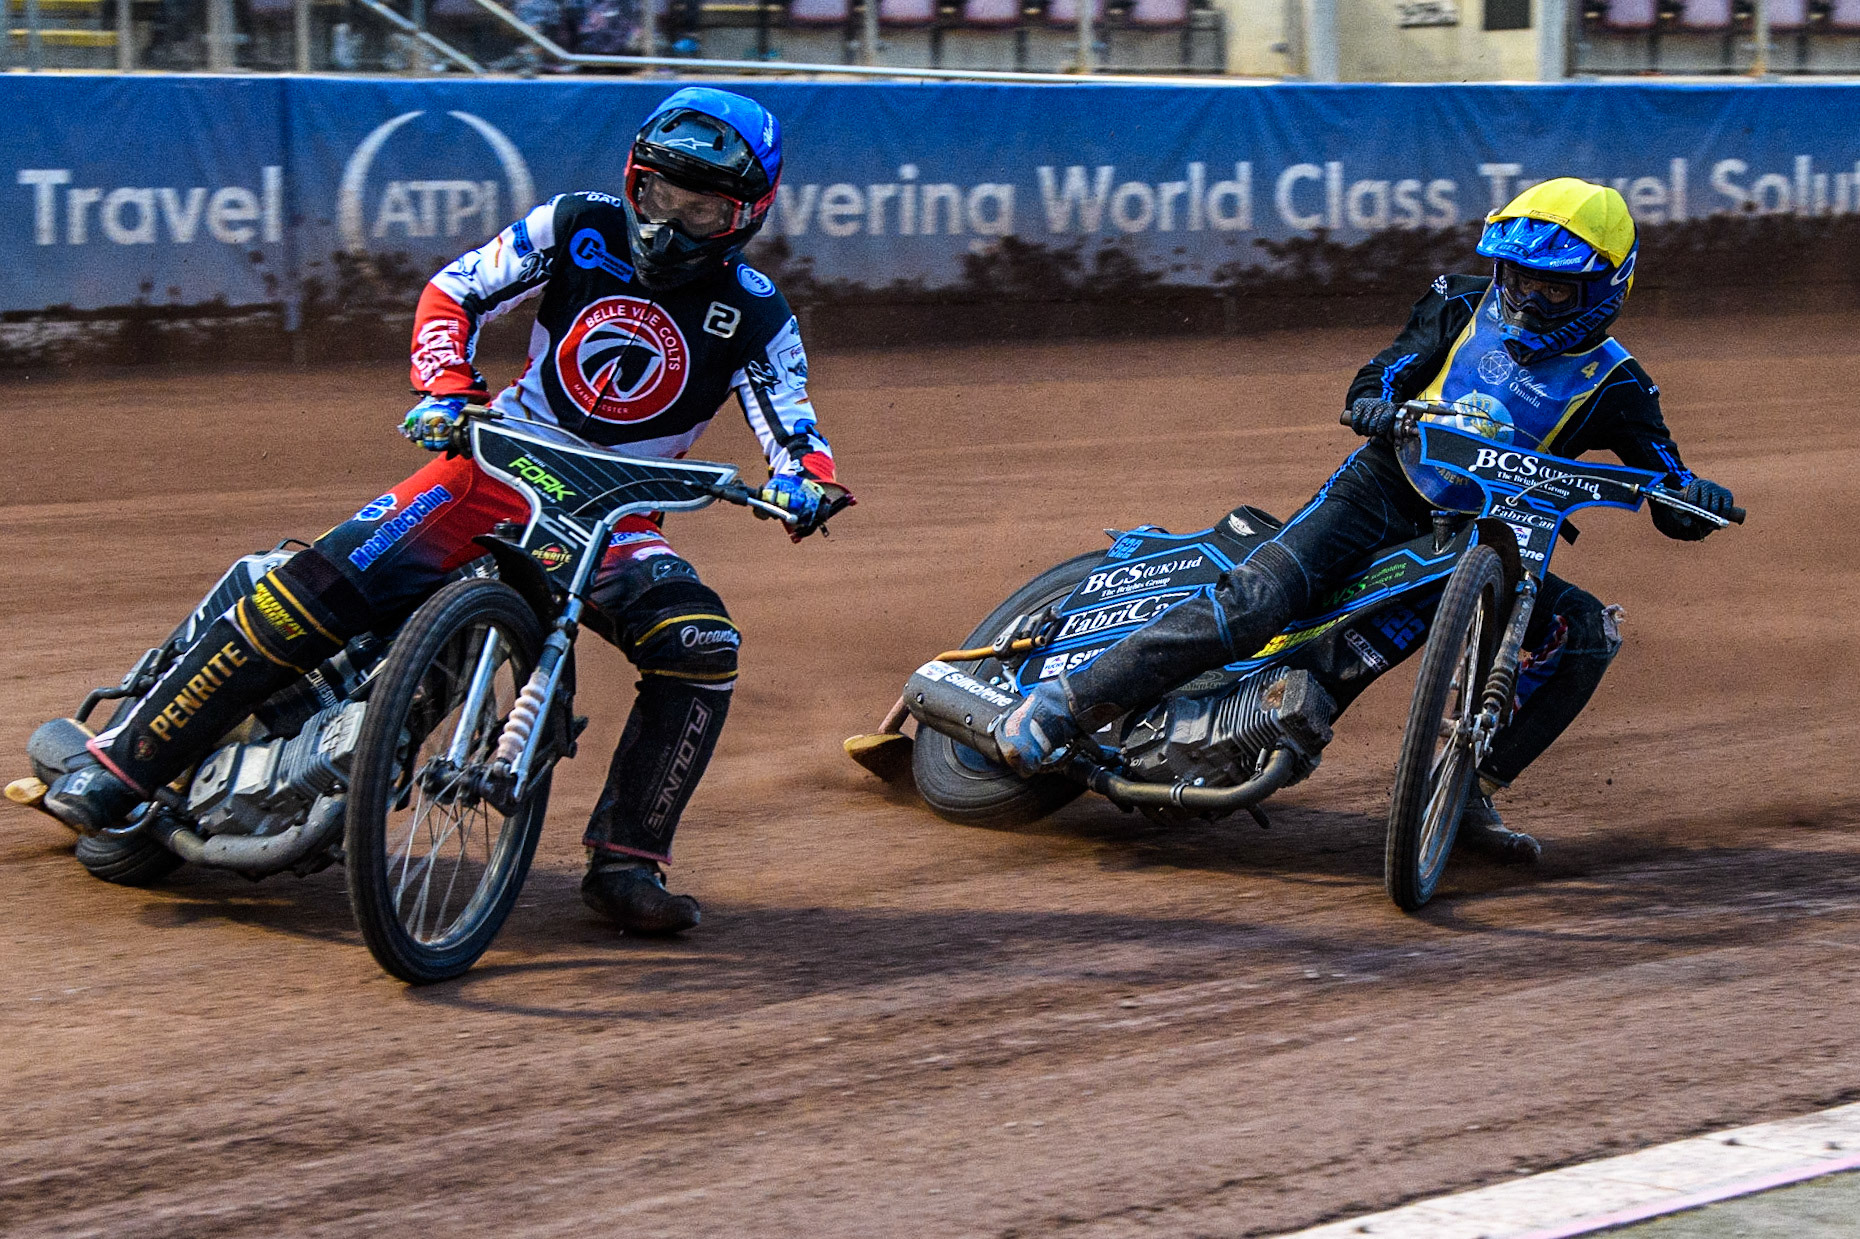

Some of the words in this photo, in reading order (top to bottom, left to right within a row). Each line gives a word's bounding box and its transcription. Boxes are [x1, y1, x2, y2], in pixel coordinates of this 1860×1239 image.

[17, 165, 283, 246] Travel
[372, 179, 499, 239] ATPI
[762, 163, 1015, 252] vering
[1036, 160, 1253, 234] World
[1275, 161, 1457, 230] Class
[744, 269, 768, 290] ATPI
[585, 304, 627, 329] BELLE
[632, 306, 661, 327] VUE
[659, 326, 681, 372] COLTS
[706, 304, 737, 336] 2
[1581, 360, 1600, 379] 4
[573, 383, 630, 414] MANCESTER
[1508, 381, 1542, 409] Omada
[508, 456, 577, 502] FORK
[1475, 448, 1540, 477] BCS
[1576, 478, 1600, 495] Ltd
[1497, 471, 1512, 482] The
[349, 528, 393, 572] Metal
[381, 483, 454, 543] Recycling
[1489, 503, 1556, 531] FabriCan
[531, 549, 573, 564] PENRITE
[1080, 562, 1147, 595] BCS
[1142, 559, 1179, 579] (UK)
[1178, 555, 1203, 572] Ltd
[1101, 588, 1116, 598] The
[1145, 576, 1171, 589] Group
[1058, 596, 1170, 639] FabriCa
[149, 640, 249, 742] PENRITE
[945, 671, 1015, 708] Silkolene
